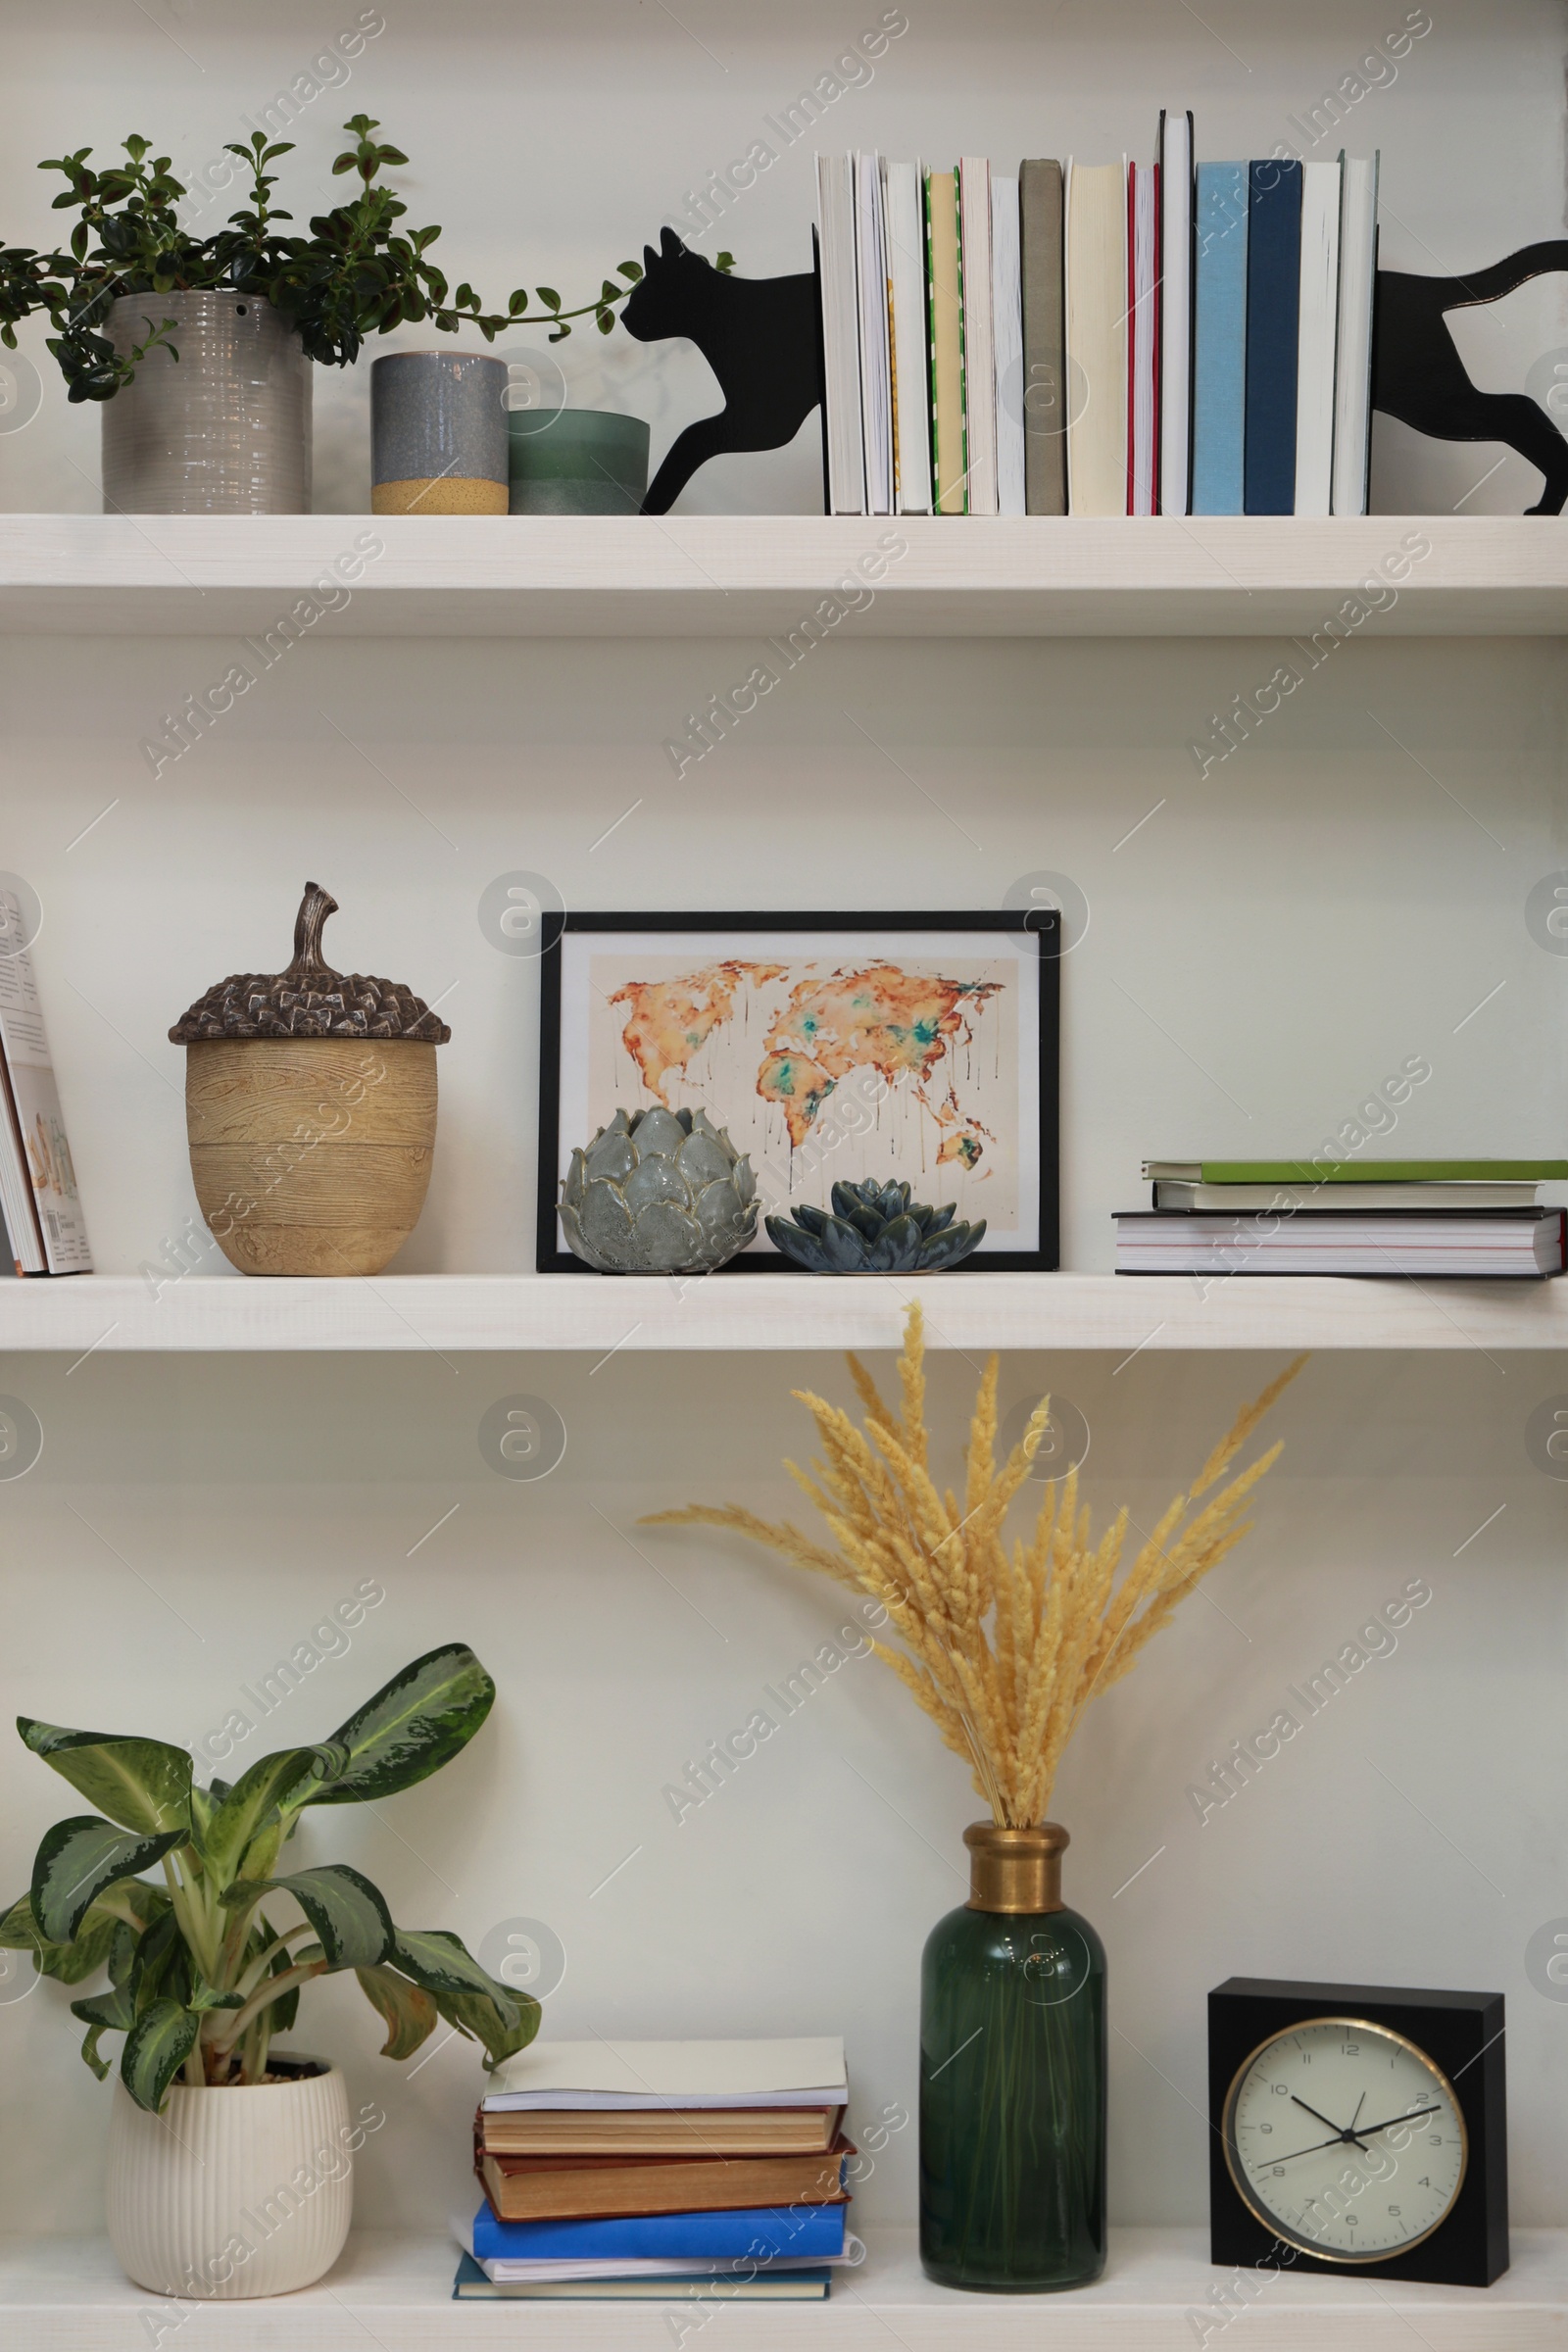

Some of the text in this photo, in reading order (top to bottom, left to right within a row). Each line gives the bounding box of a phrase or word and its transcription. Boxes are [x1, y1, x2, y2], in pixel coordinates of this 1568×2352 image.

[1342, 2044, 1360, 2056] 12
[1303, 2053, 1311, 2065] 11
[1270, 2083, 1289, 2096] 10
[1415, 2092, 1430, 2104] 2
[1259, 2123, 1273, 2134] 9
[1429, 2134, 1443, 2146] 3
[1272, 2166, 1286, 2178] 8
[1417, 2177, 1431, 2188] 4
[1304, 2198, 1316, 2210] 7
[1388, 2205, 1401, 2217] 5
[1346, 2215, 1358, 2226] 6
